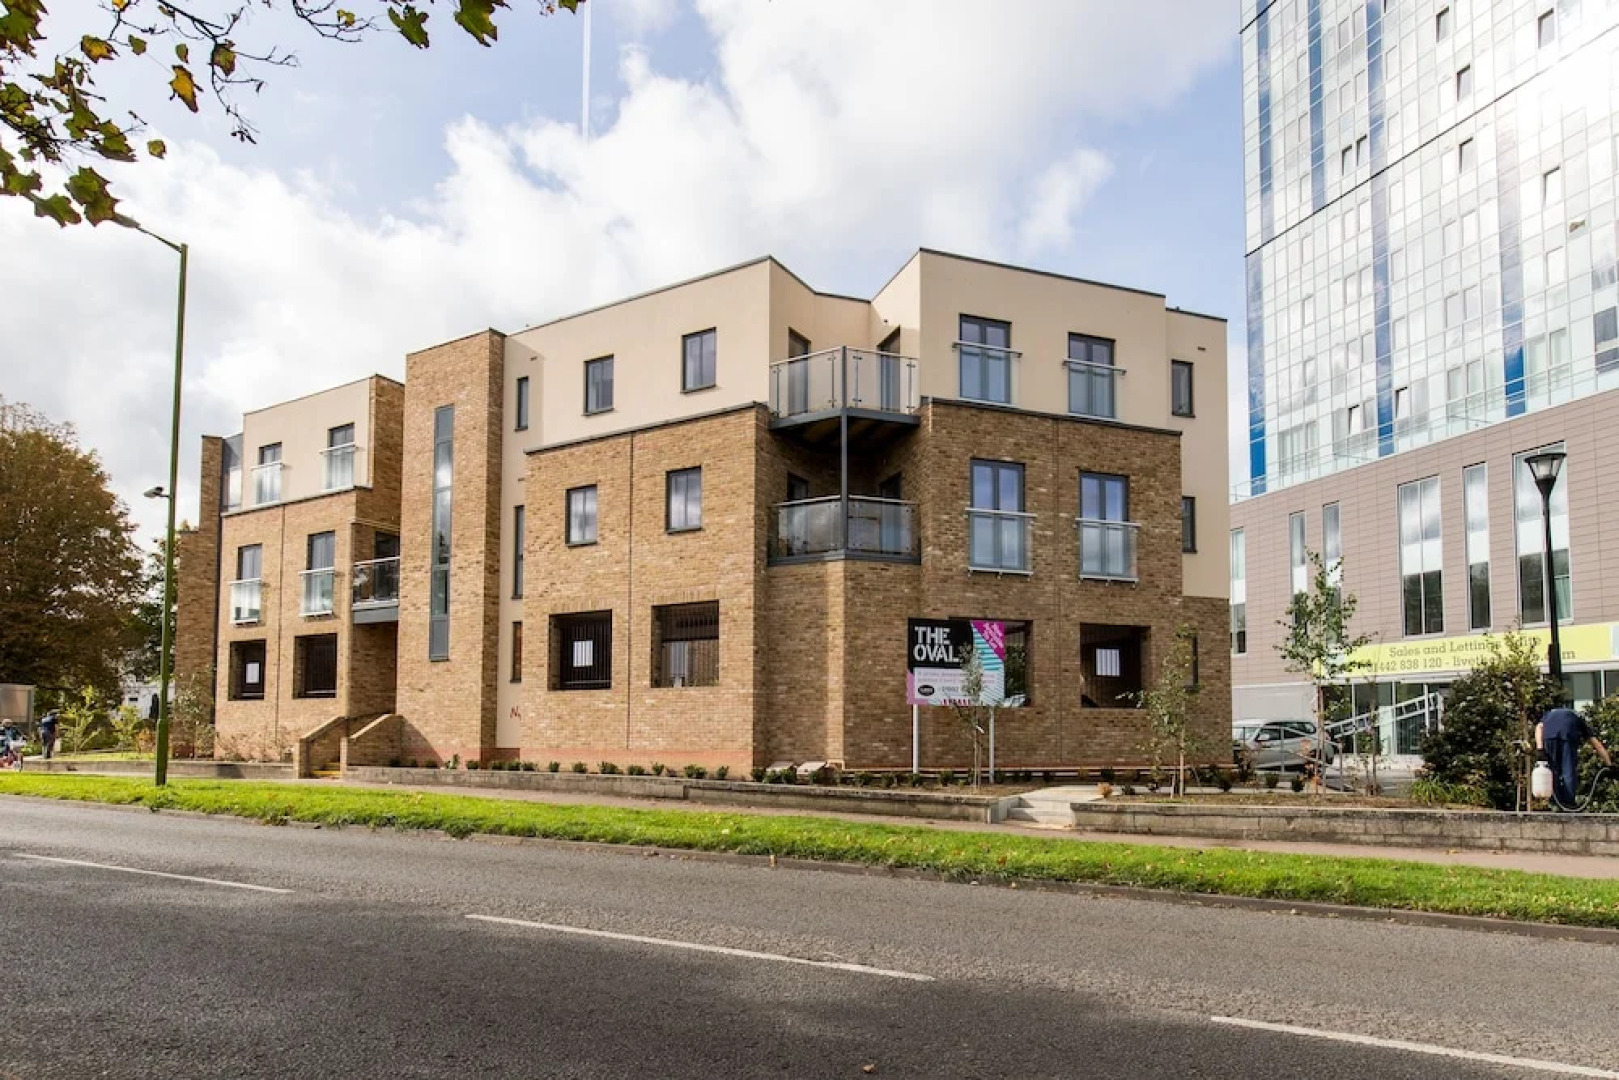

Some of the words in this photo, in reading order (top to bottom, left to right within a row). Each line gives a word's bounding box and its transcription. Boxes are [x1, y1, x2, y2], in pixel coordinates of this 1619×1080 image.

[914, 626, 950, 645] THE
[1389, 645, 1420, 658] Sales
[1422, 642, 1447, 655] and
[1400, 658, 1419, 670] 838
[1423, 656, 1442, 669] 120
